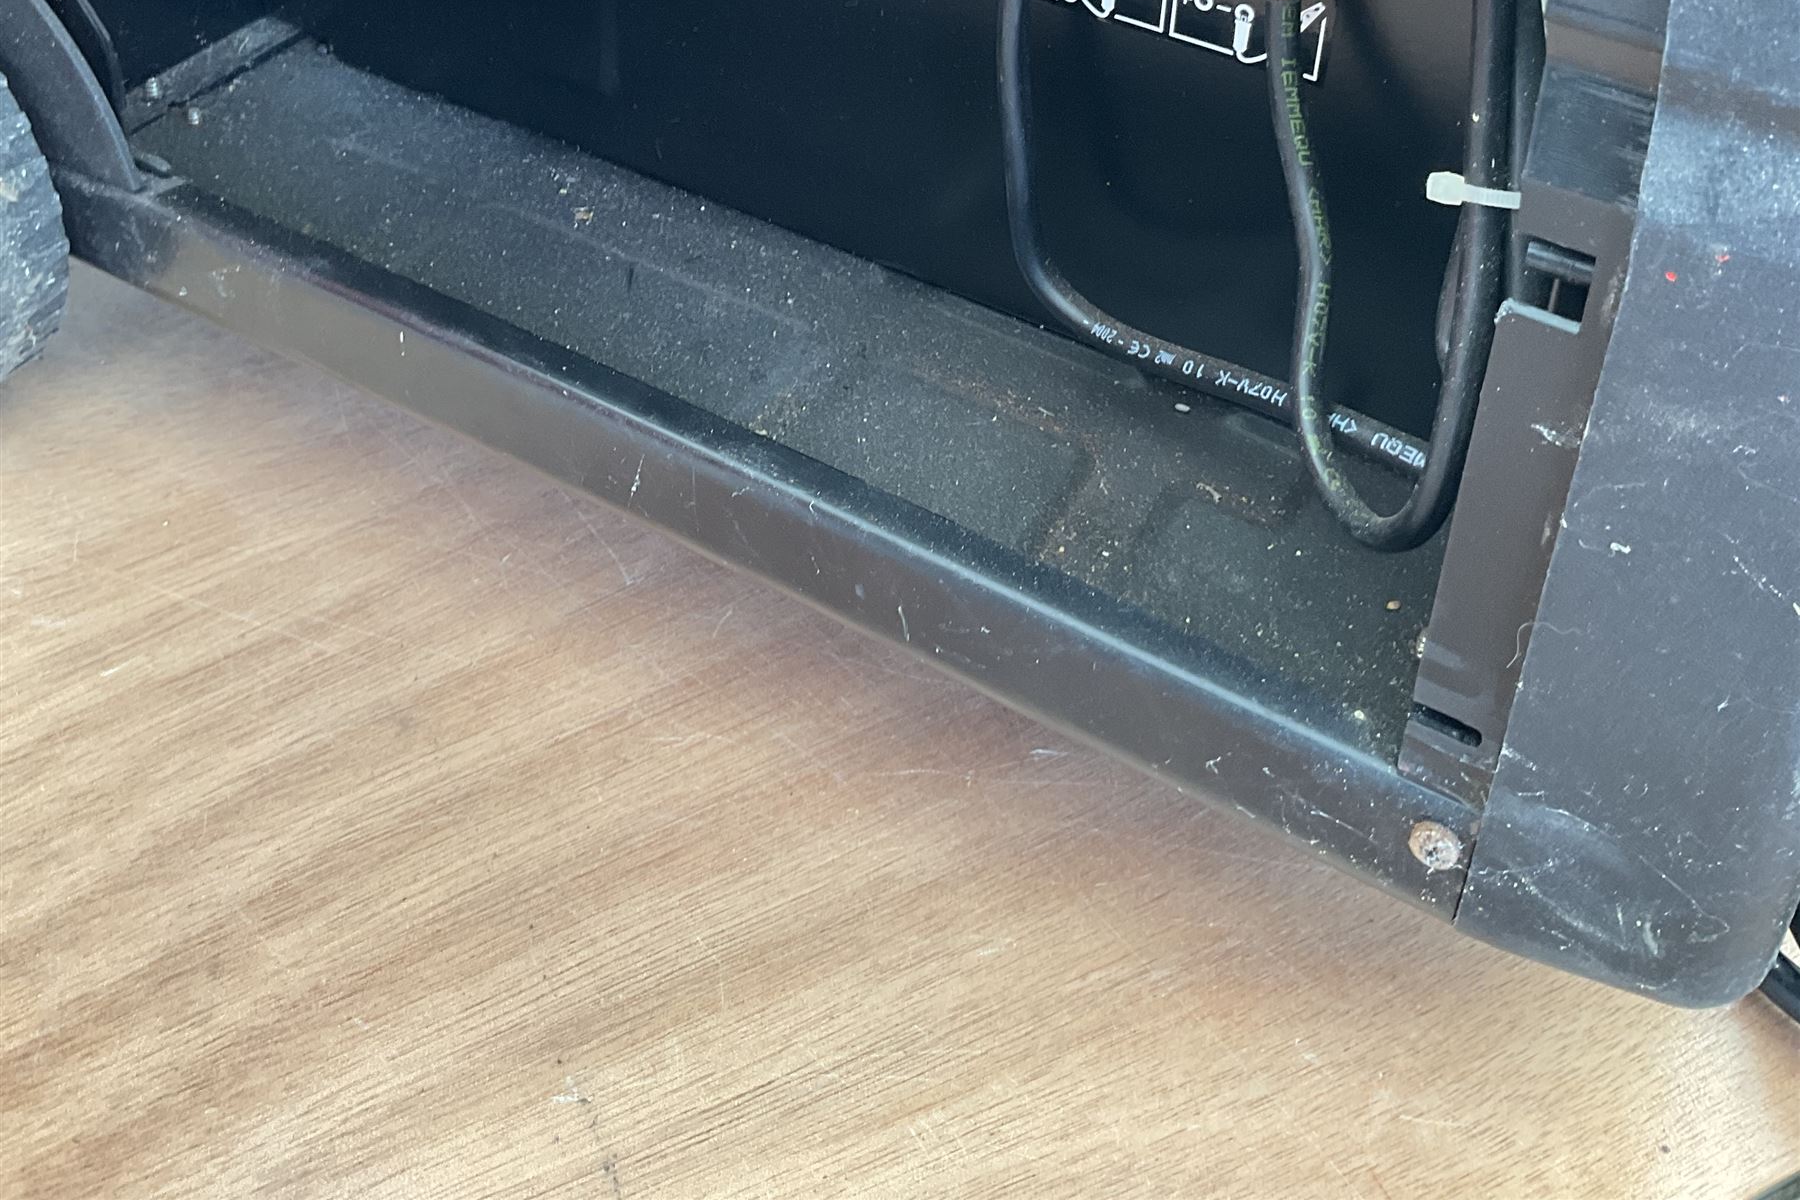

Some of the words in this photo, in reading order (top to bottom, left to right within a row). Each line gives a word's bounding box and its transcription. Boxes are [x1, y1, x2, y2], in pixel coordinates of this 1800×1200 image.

[1127, 340, 1151, 358] CE
[1182, 360, 1205, 379] 10
[1215, 369, 1288, 407] H07V-K
